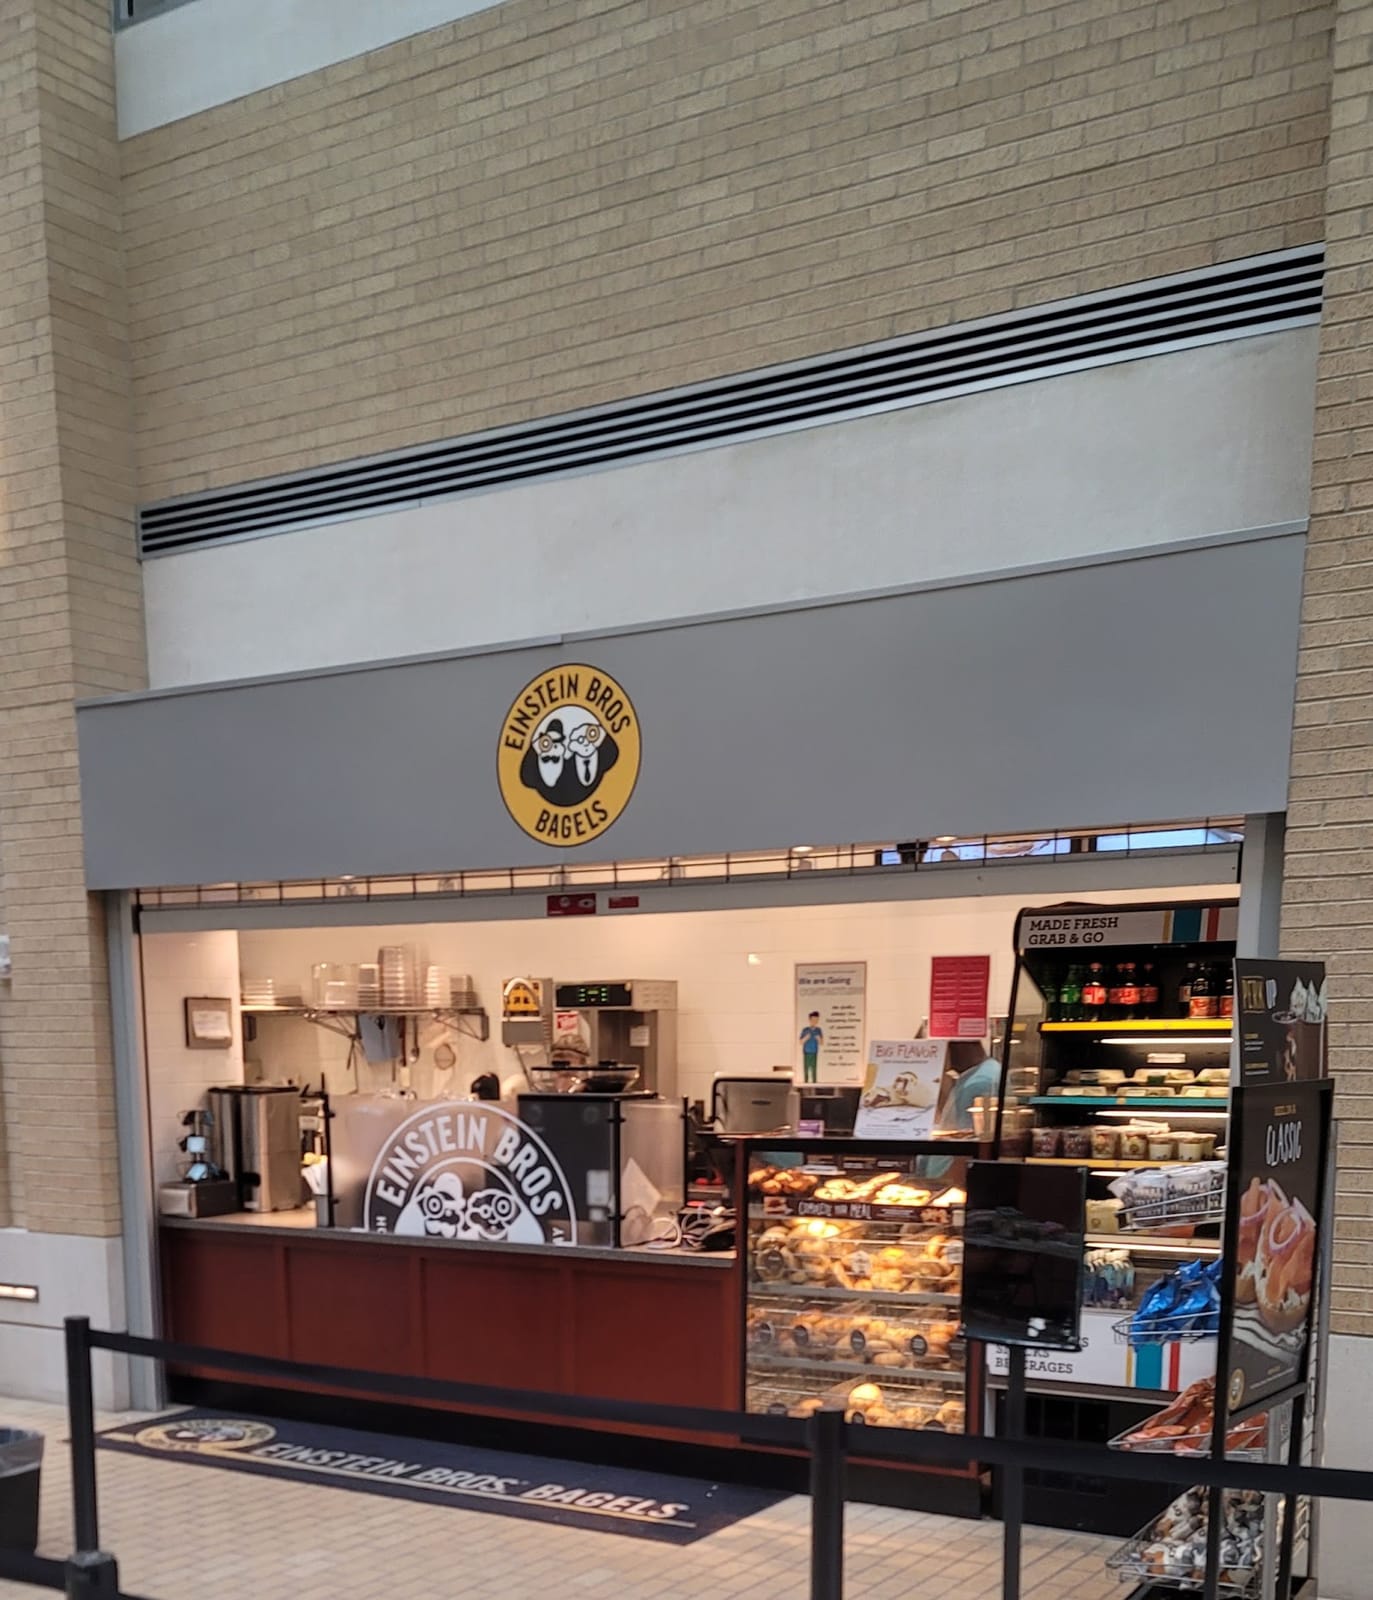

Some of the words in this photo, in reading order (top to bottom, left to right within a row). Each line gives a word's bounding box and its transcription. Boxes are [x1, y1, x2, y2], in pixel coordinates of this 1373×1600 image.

[505, 674, 579, 750] EINSTEIN
[585, 677, 630, 734] BROS
[535, 800, 608, 839] BAGELS
[1028, 933, 1066, 945] GRAB
[1069, 933, 1079, 943] &
[1082, 932, 1104, 943] GO
[1029, 919, 1072, 931] MADE
[1074, 917, 1119, 929] FRESH
[897, 1044, 938, 1058] FLAVOR
[376, 1113, 488, 1207] EINSTEIN
[493, 1129, 563, 1216] BROS
[1265, 1121, 1302, 1167] CLASSIC
[253, 1442, 422, 1477] EINSTEIN
[519, 1483, 690, 1519] BAGELS
